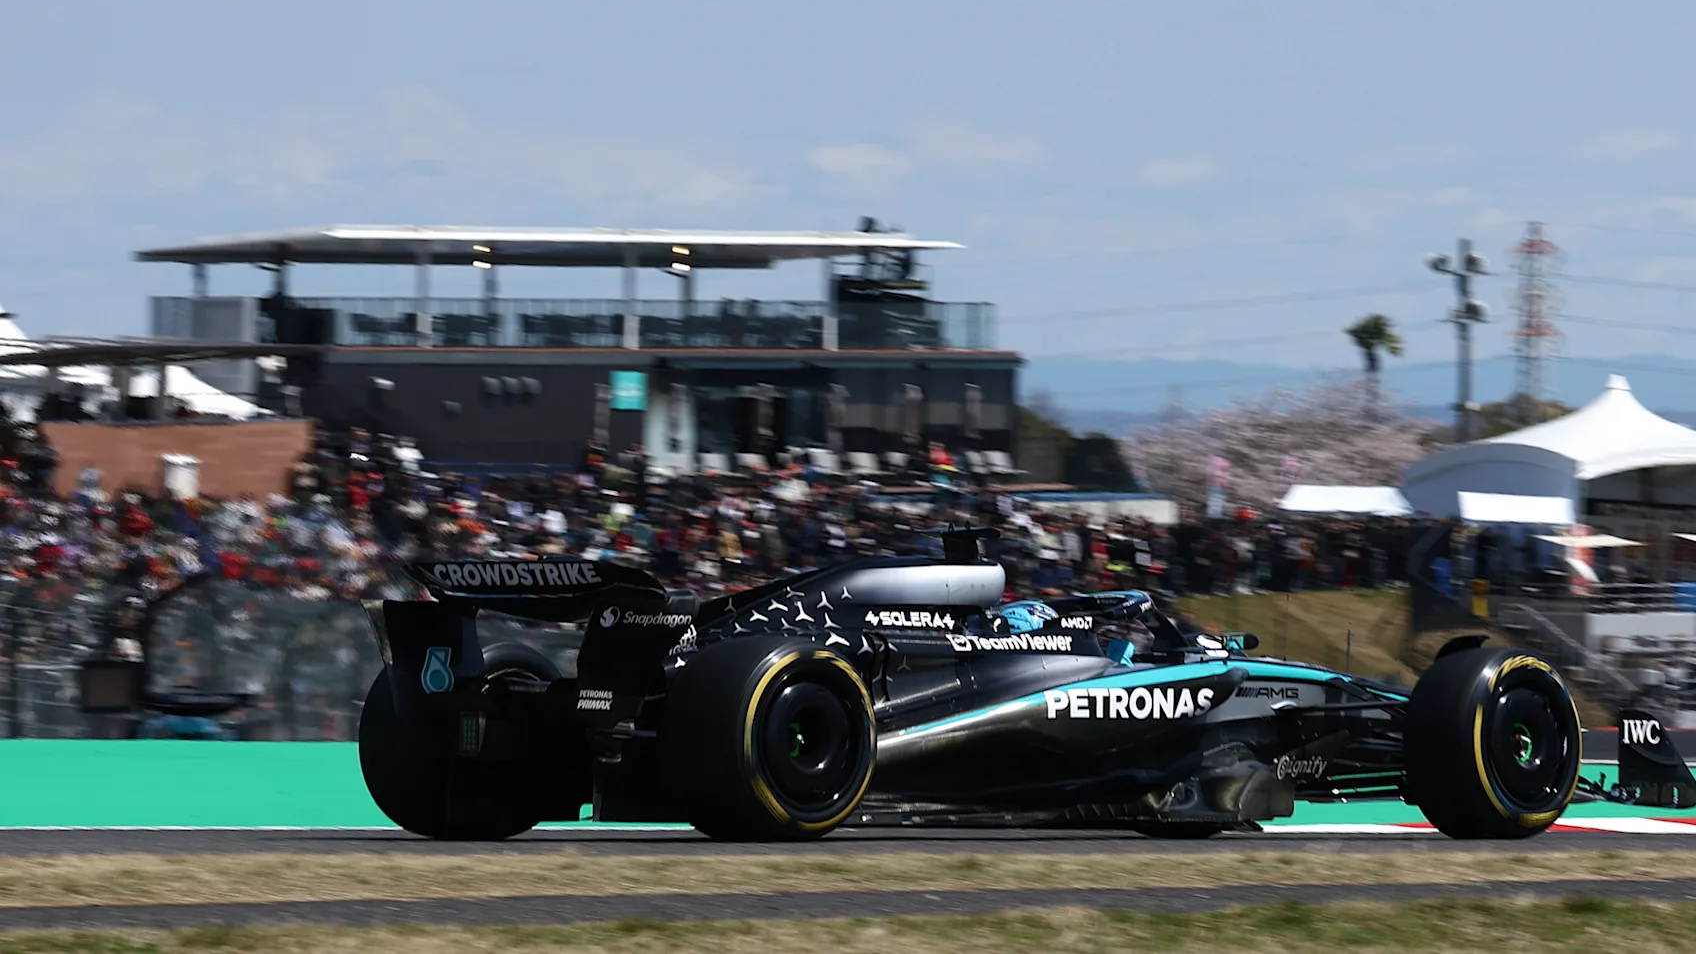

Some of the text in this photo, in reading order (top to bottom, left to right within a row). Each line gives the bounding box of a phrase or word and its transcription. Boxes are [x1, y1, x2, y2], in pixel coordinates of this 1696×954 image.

[434, 562, 602, 587] CROWDSTRIKE
[623, 611, 692, 628] Snapdragon
[880, 611, 944, 628] SOLERA
[1061, 616, 1086, 630] AMD
[968, 634, 1073, 652] TeamViewer
[579, 688, 613, 699] PETRONAS
[1256, 687, 1299, 699] AMG
[577, 698, 613, 711] PRIMAX
[1043, 687, 1215, 720] PETRONAS
[1622, 719, 1661, 745] IWC
